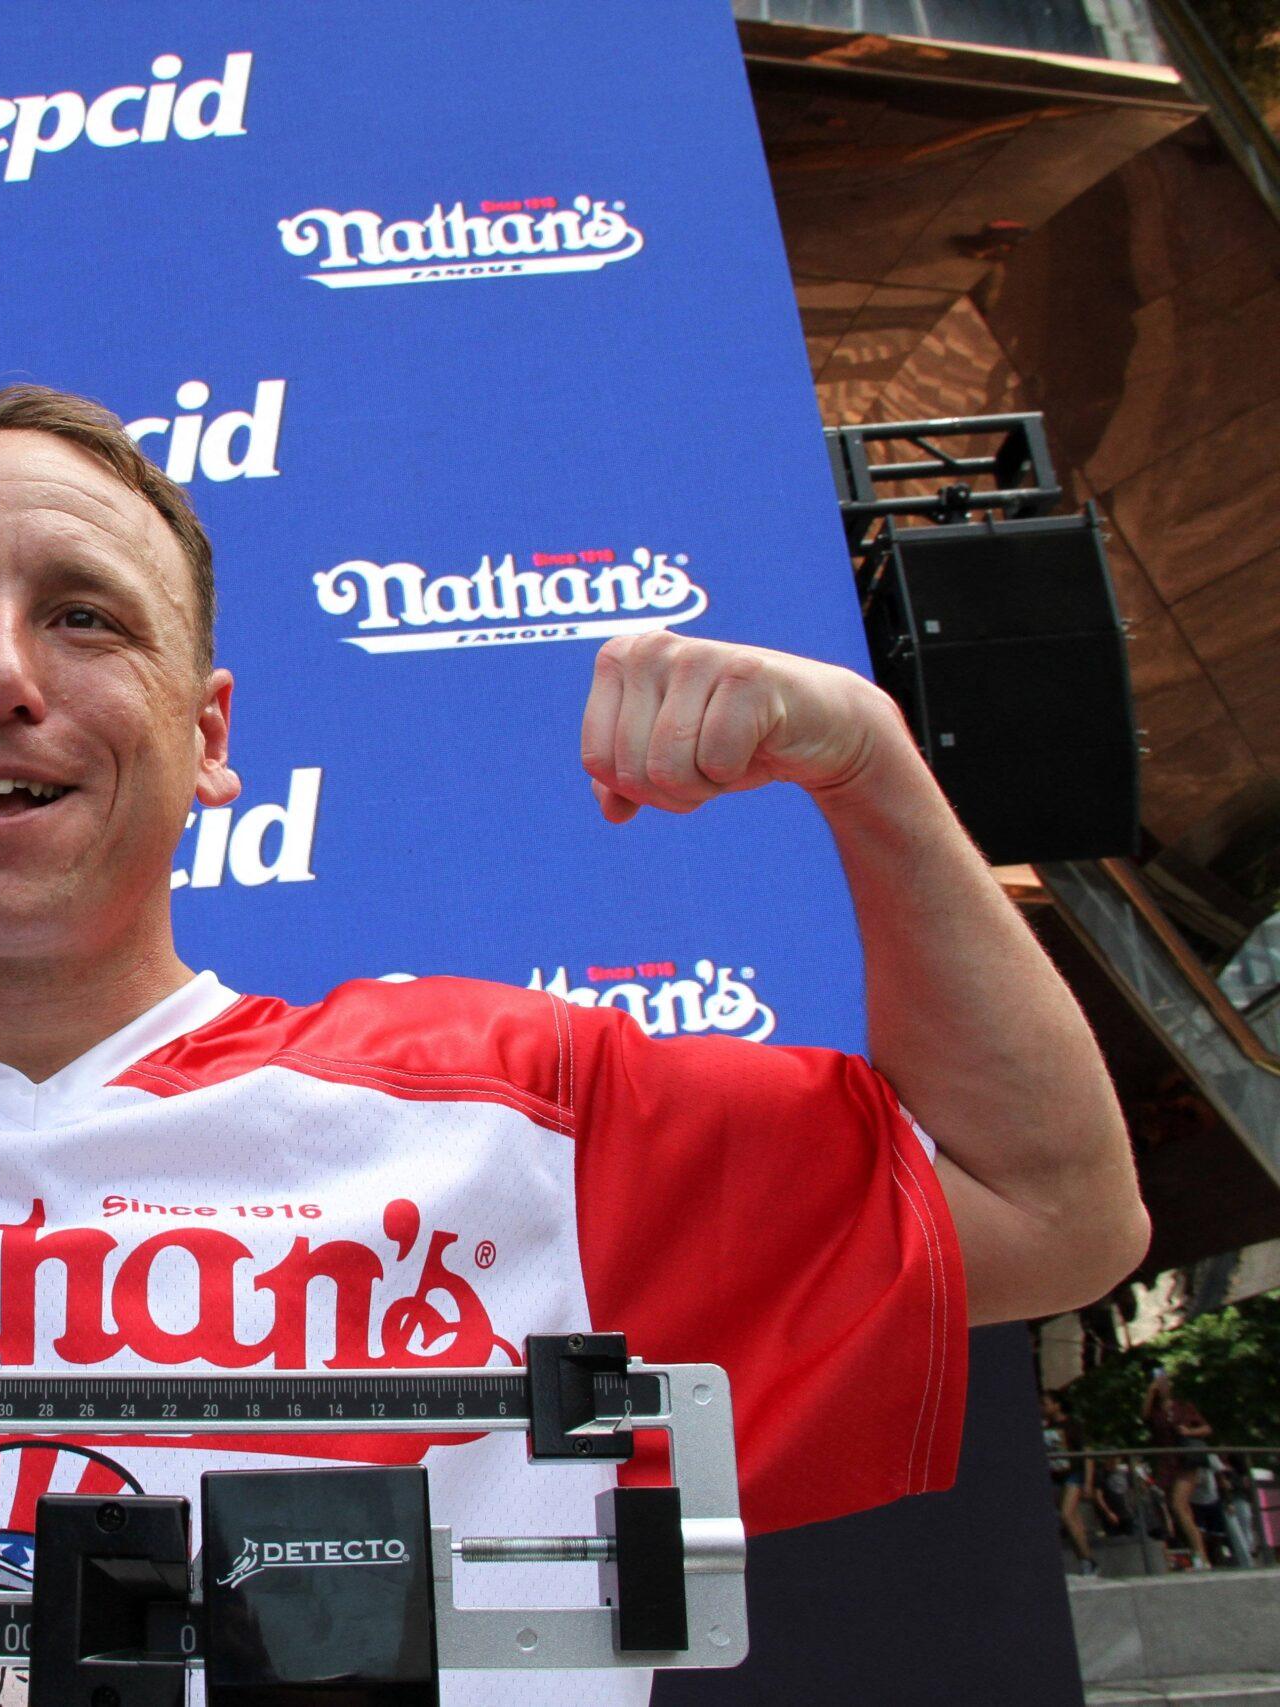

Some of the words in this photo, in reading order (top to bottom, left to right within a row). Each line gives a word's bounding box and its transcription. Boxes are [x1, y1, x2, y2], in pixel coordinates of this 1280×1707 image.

[276, 195, 627, 268] Nathan's
[312, 547, 691, 629] Nathan's
[102, 1195, 218, 1217] Since
[230, 1204, 322, 1219] 1916
[38, 1403, 53, 1417] 28
[80, 1403, 95, 1417] 26
[121, 1403, 136, 1417] 24
[162, 1403, 177, 1417] 22
[203, 1403, 218, 1417] 20
[246, 1403, 260, 1417] 18
[287, 1403, 302, 1417] 16
[329, 1403, 343, 1417] 14
[371, 1403, 385, 1417] 12
[413, 1402, 427, 1416] 10
[457, 1402, 465, 1416] 8
[499, 1402, 507, 1416] 6
[263, 1539, 405, 1562] DETECTO
[180, 1625, 195, 1652] 0
